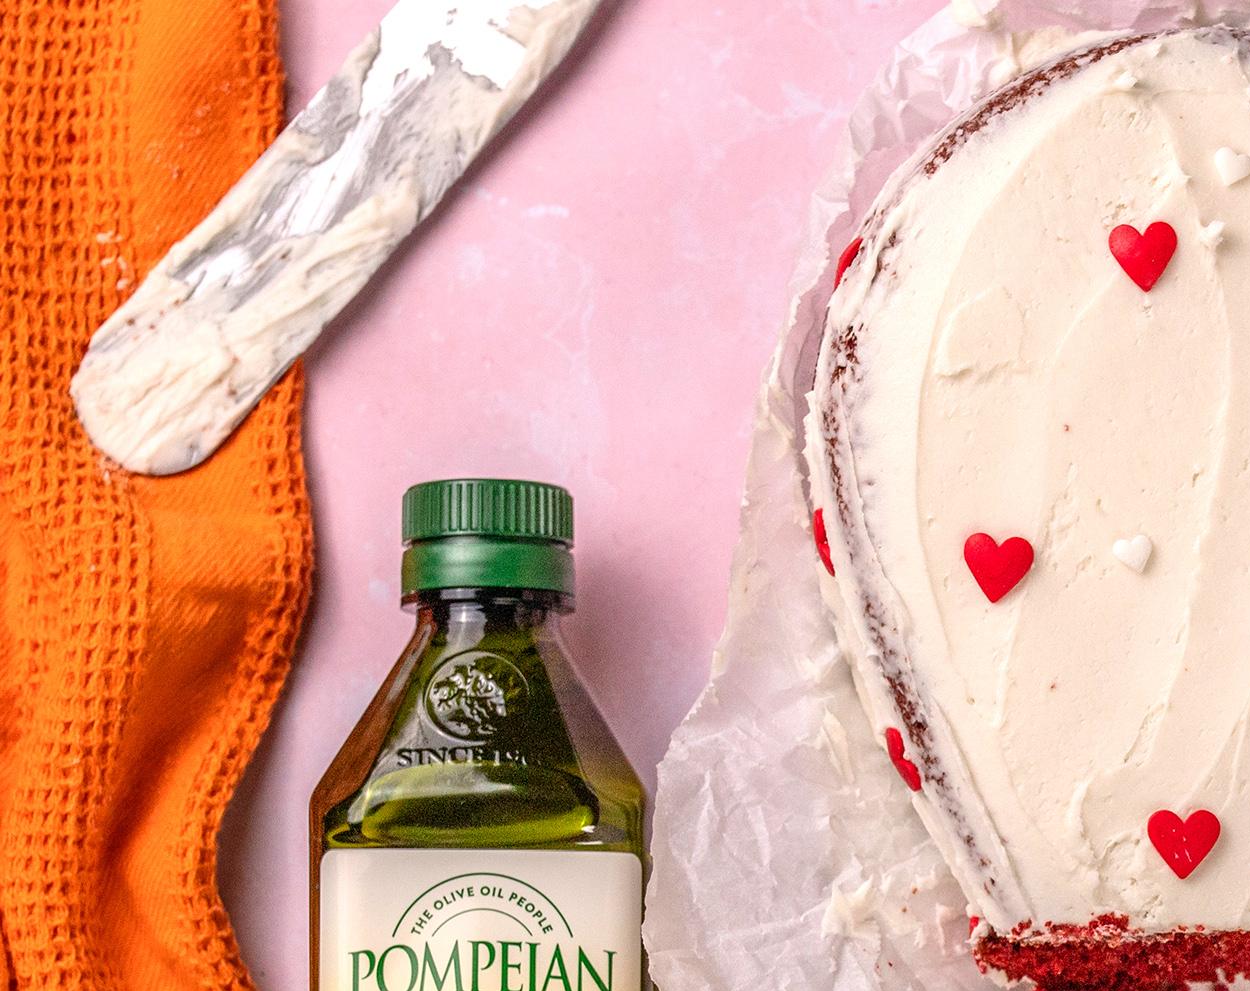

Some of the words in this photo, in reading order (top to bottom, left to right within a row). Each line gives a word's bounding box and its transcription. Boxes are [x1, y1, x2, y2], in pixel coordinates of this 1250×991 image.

[397, 747, 484, 766] SINCE
[411, 909, 433, 935] THE
[433, 886, 475, 911] OLIVE
[480, 886, 504, 899] OIL
[508, 892, 553, 934] PEOPLE
